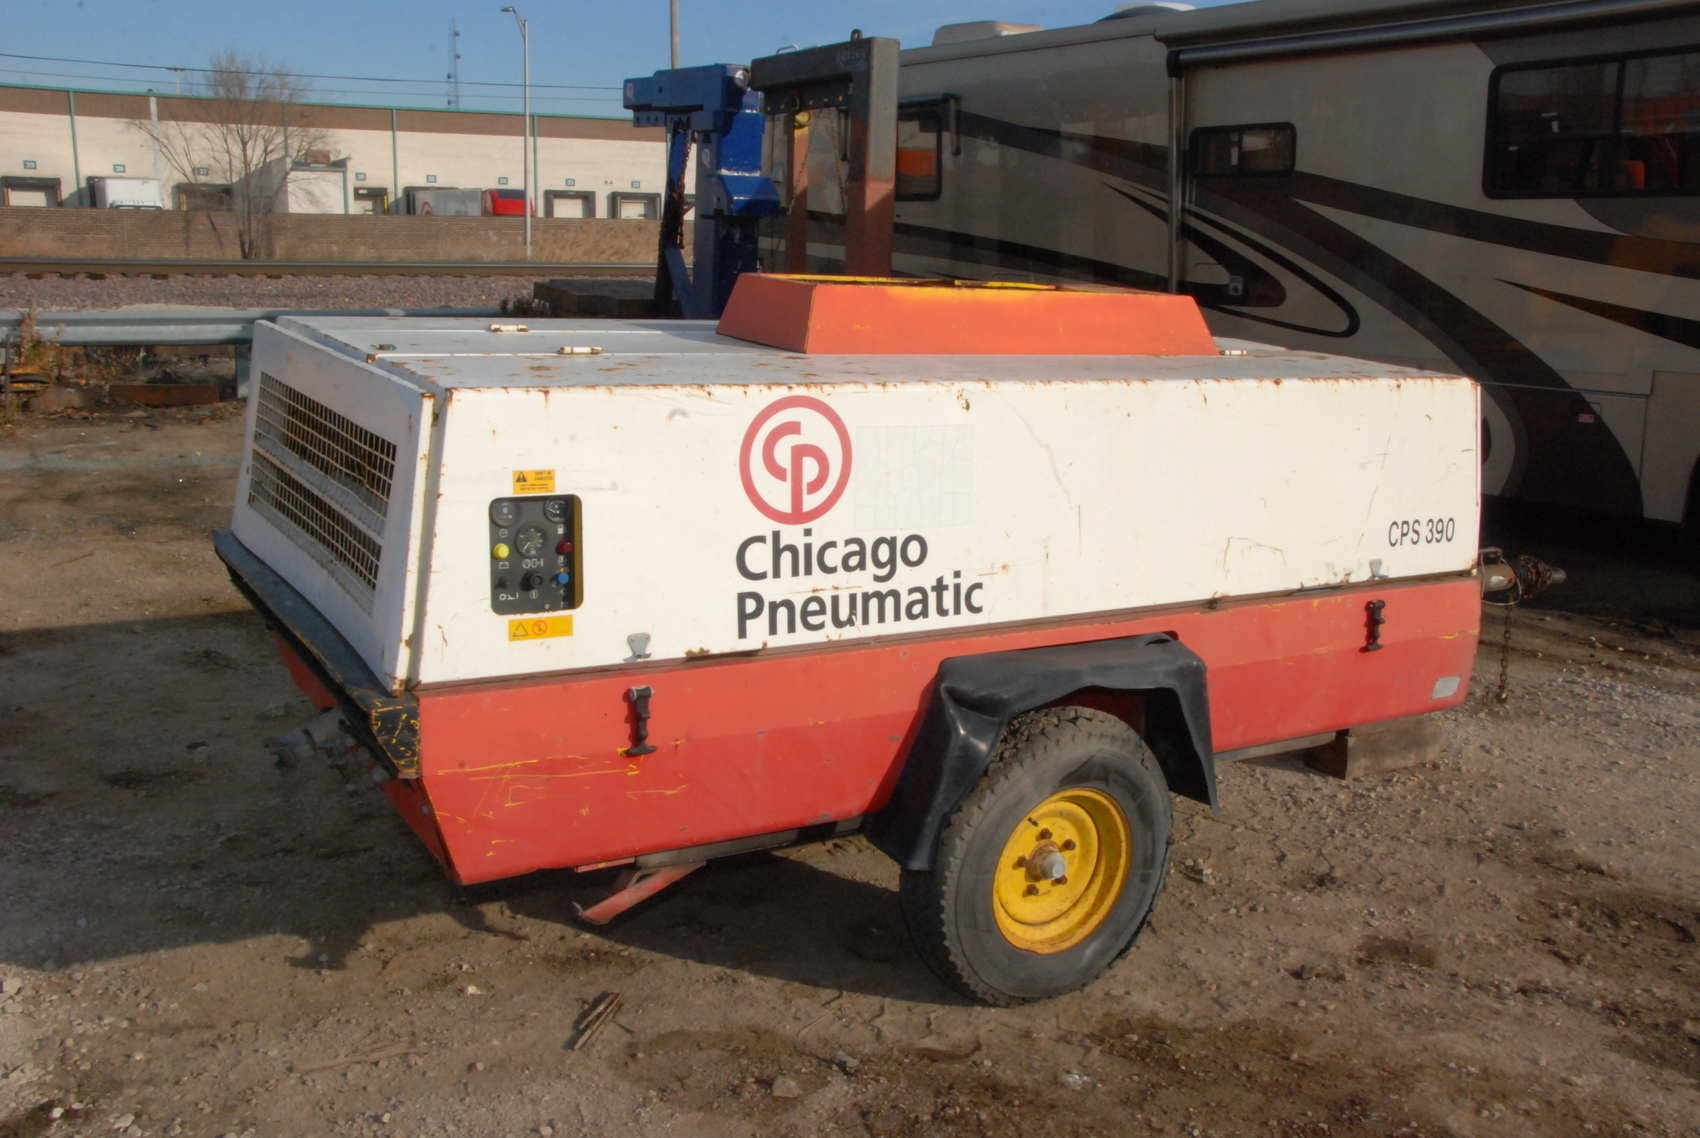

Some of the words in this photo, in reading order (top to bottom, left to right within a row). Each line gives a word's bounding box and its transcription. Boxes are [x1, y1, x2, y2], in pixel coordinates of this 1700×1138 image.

[25, 161, 35, 169] 39
[1388, 518, 1421, 547] CPS
[1425, 517, 1455, 544] 390
[736, 528, 928, 582] Chicago
[737, 570, 983, 639] Pneumatic
